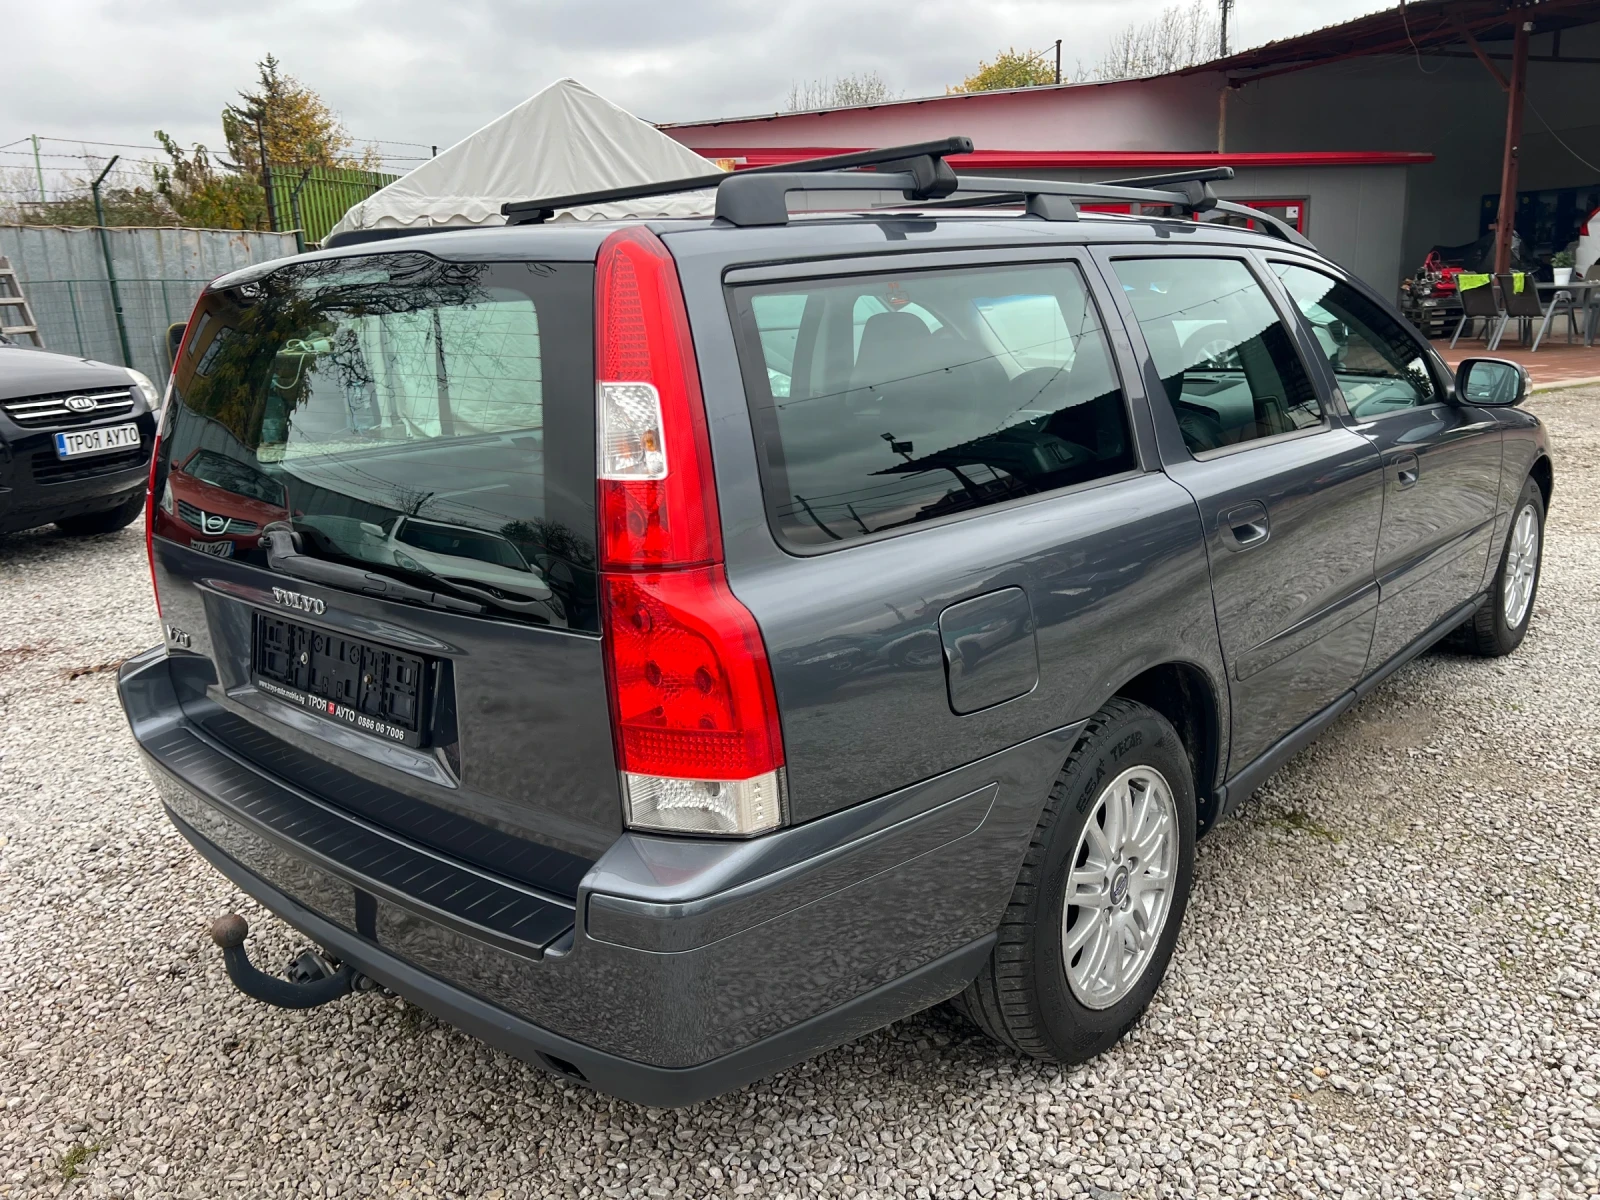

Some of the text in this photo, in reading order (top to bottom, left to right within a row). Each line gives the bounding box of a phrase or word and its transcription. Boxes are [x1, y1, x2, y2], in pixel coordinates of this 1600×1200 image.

[70, 398, 94, 409] KIA
[271, 586, 326, 615] VOLVO
[308, 694, 405, 740] ТРОЯ АУТО 0886 06 7006
